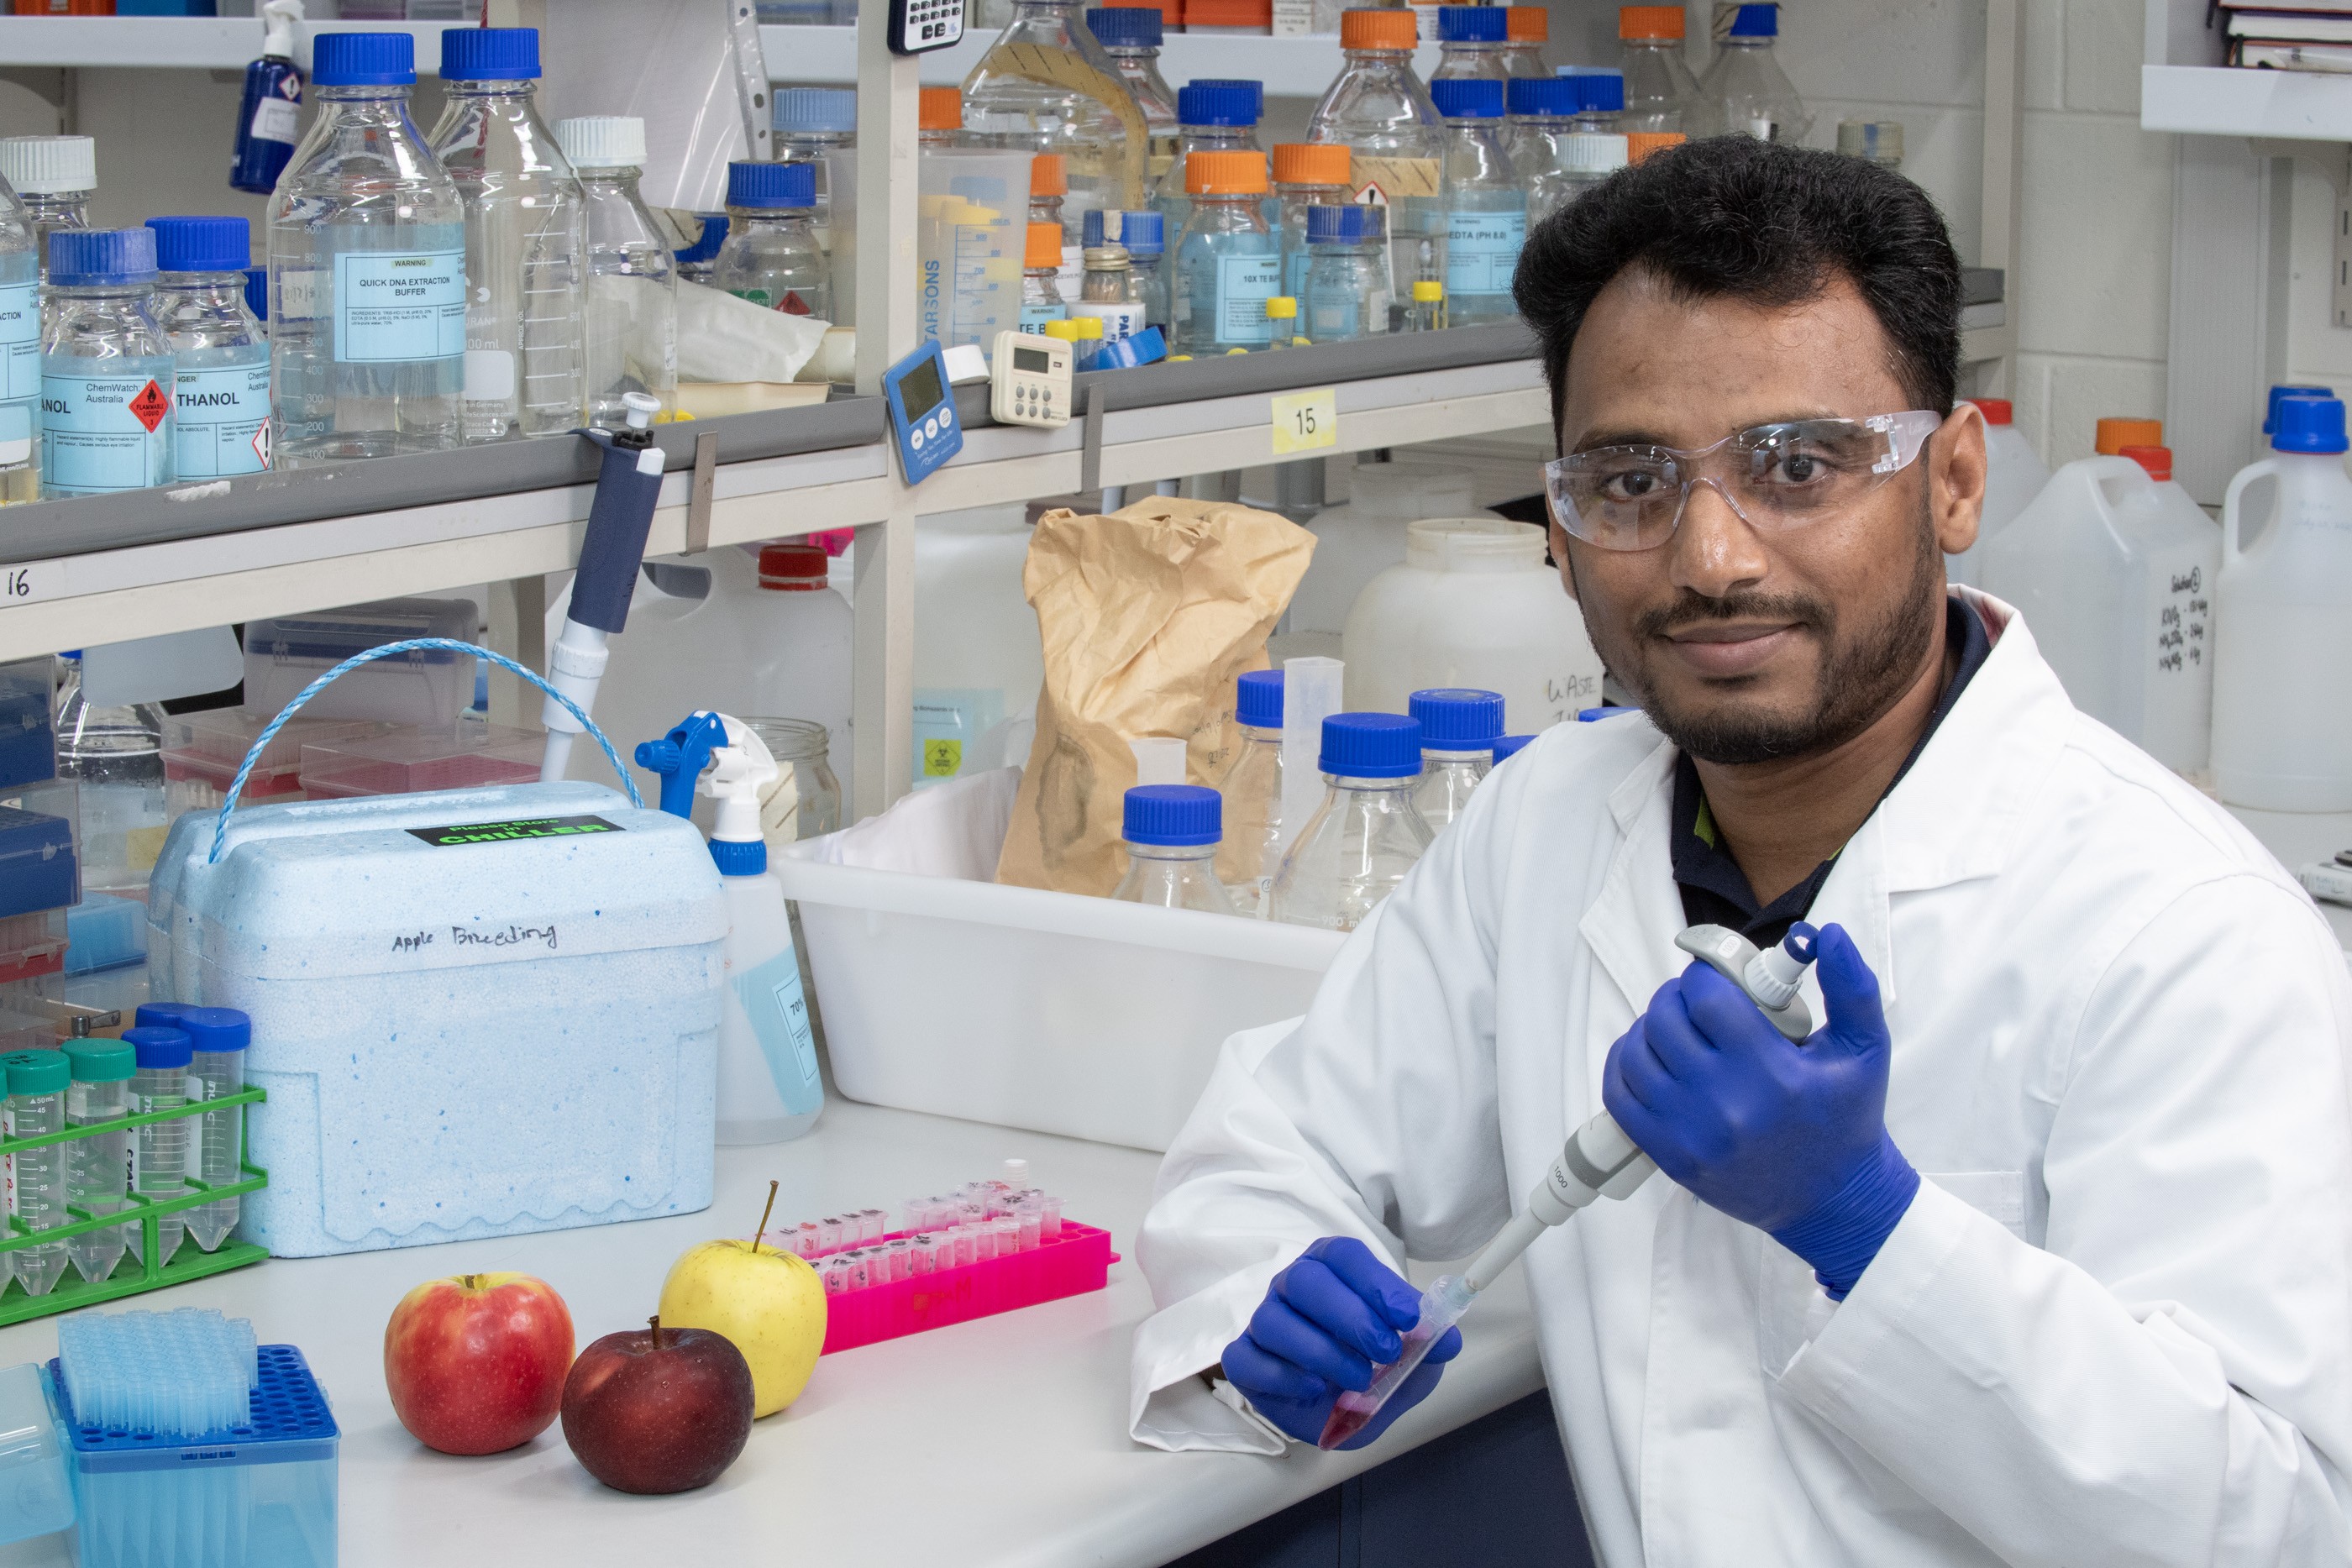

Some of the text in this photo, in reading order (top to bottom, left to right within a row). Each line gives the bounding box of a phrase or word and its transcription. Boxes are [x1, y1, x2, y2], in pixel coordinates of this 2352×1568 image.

[304, 224, 322, 234] 900
[1449, 231, 1473, 239] EDTA
[304, 253, 322, 262] 800
[360, 279, 386, 287] QUICK
[408, 276, 450, 286] EXTRACTION
[1244, 275, 1257, 283] 10X
[395, 288, 426, 296] BUFFER
[305, 338, 323, 347] 500
[485, 338, 500, 349] ml
[570, 339, 580, 349] 400
[306, 365, 323, 375] 400
[570, 368, 581, 378] 300
[86, 383, 140, 392] ChemWatch;
[86, 395, 123, 403] Australia
[177, 392, 240, 406] THANOL
[307, 393, 324, 403] 300
[307, 421, 324, 431] 200
[1296, 407, 1316, 435] 15
[8, 569, 29, 597] 16
[1548, 674, 1597, 703] WASTE
[449, 819, 560, 832] Please Store
[438, 824, 610, 844] CHILLER
[1322, 915, 1344, 927] 900
[391, 931, 434, 952] Apple
[1554, 1166, 1568, 1188] 1000
